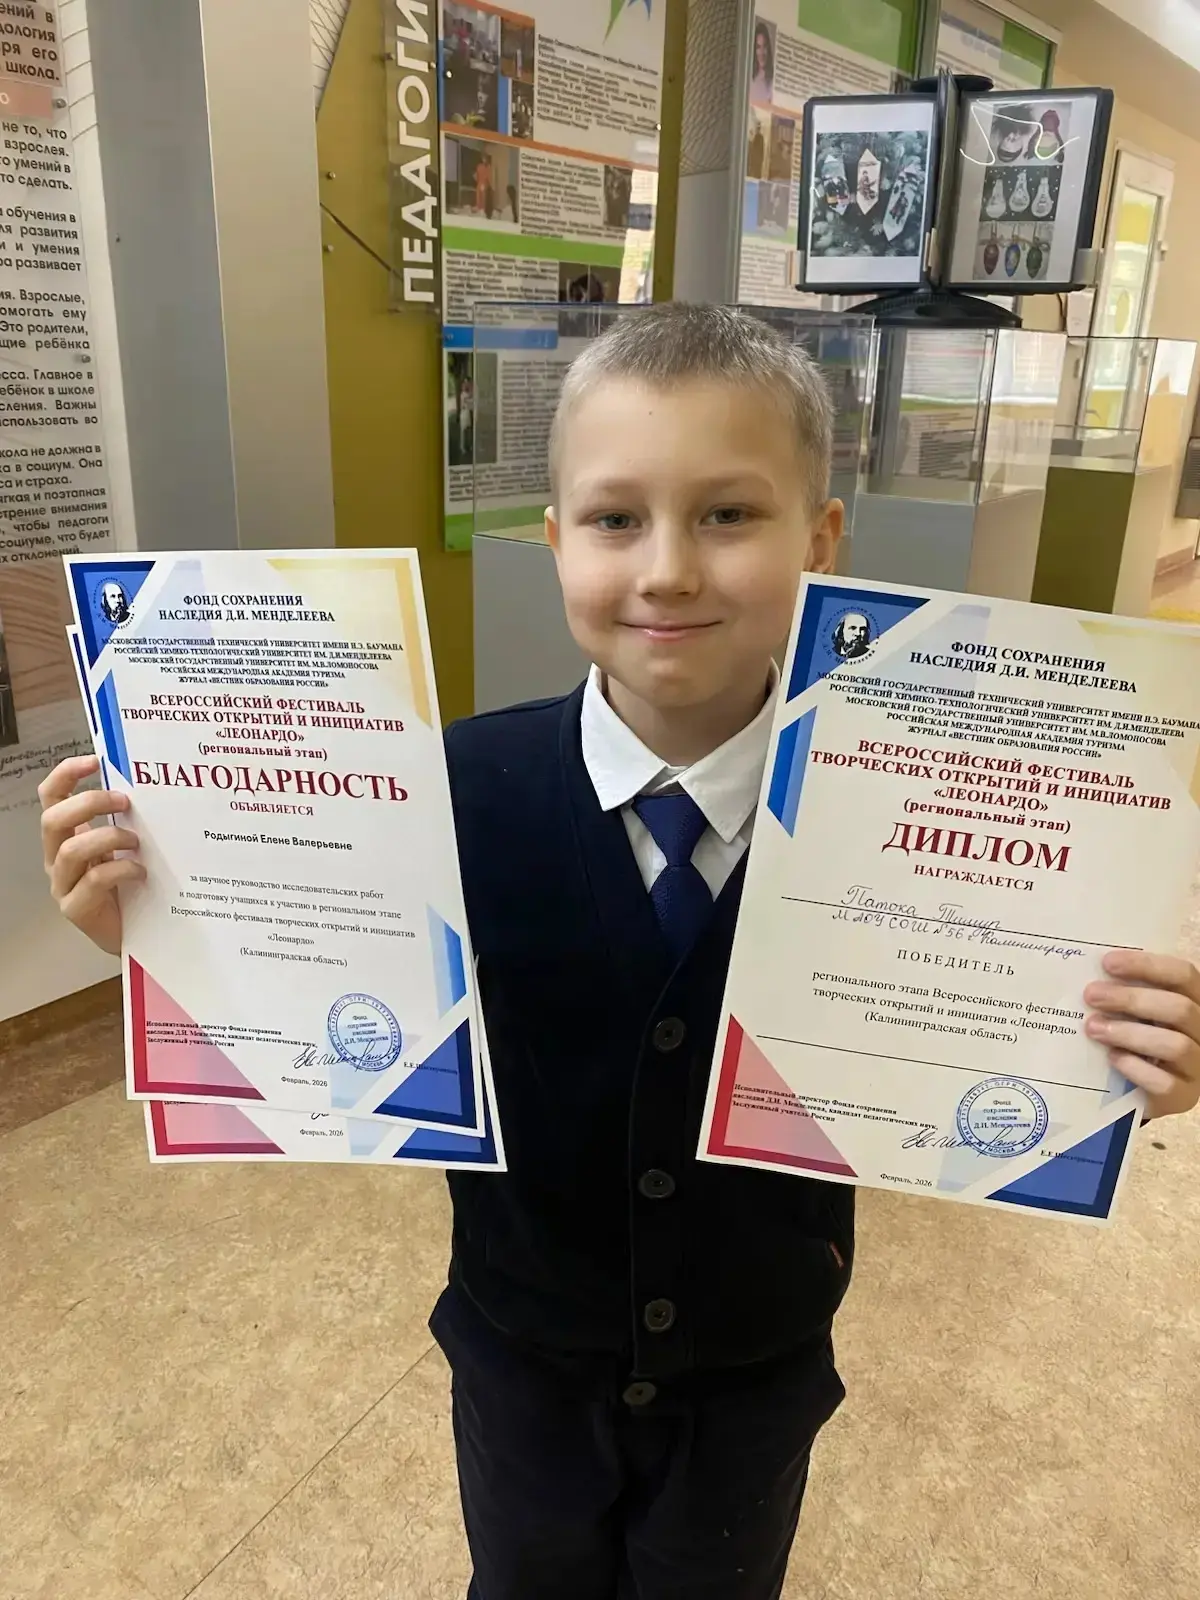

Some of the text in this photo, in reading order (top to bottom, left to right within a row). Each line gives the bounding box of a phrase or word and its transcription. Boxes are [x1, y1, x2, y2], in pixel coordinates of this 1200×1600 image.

[45, 11, 53, 23] в
[31, 47, 58, 62] его
[5, 61, 59, 80] школа.
[2, 122, 67, 139] не то, что
[4, 139, 69, 156] взрослея.
[12, 157, 70, 173] умений в
[18, 175, 72, 190] сделать.
[6, 206, 76, 222] обучения в
[20, 226, 78, 239] развития
[15, 242, 79, 255] и умения
[15, 258, 81, 271] развивает
[19, 289, 85, 305] Взрослые,
[62, 309, 86, 321] ему
[0, 320, 88, 336] Это родители,
[35, 337, 90, 351] ребёнка
[33, 368, 93, 380] Главное в
[48, 387, 54, 395] в
[57, 386, 94, 395] школе
[55, 399, 96, 410] Важны
[84, 416, 98, 424] во
[30, 448, 45, 456] не
[48, 445, 92, 456] должна
[15, 458, 102, 472] в социум. Она
[15, 476, 72, 488] и страха.
[33, 488, 106, 501] и поэтапная
[50, 502, 107, 514] внимания
[13, 516, 108, 532] чтобы педагоги
[57, 533, 76, 542] что
[78, 529, 109, 541] будет
[183, 594, 303, 606] ФОНД СОХРАНЕНИЯ
[159, 609, 335, 622] НАСЛЕДИЯ Д.И. МЕНДЕЛЕЕВА
[951, 642, 1105, 672] ФОНД СОХРАНЕНИЯ
[910, 652, 1136, 693] НАСЛЕДИЯ Д.И. МЕНДЕЛЕЕВА
[150, 693, 364, 713] ВСЕРОССИЙСКИЙ ФЕСТИВАЛЬ
[829, 683, 892, 698] РОССИЙСКИЙ
[894, 692, 1029, 716] ХИМИКО-ТЕХНОЛОГИЧЕСКИЙ
[1031, 710, 1095, 725] УНИВЕРСИТЕТ
[1096, 719, 1112, 728] ИМ.
[121, 708, 404, 731] ТВОРЧЕСКИХ ОТКРЫТИЙ И ИНИЦИАТИВ
[845, 696, 910, 711] МОСКОВСКИЙ
[912, 705, 1004, 724] ГОСУДАРСТВЕННЫЙ
[1006, 718, 1070, 732] УНИВЕРСИТЕТ
[1072, 727, 1088, 735] ИМ.
[216, 727, 304, 743] «ЛЕОНАРДО»
[886, 712, 1124, 750] РОССИЙСКАЯ МЕЖДУНАРОДНАЯ АКАДЕМИЯ ТУРИЗМА
[198, 742, 327, 761] (региональный этап)
[857, 740, 1134, 788] ВСЕРОССИЙСКИЙ ФЕСТИВАЛЬ
[134, 761, 408, 801] БЛАГОДАРНОСТЬ
[810, 750, 1171, 809] ТВОРЧЕСКИХ ОТКРЫТИЙ И ИНИЦИАТИВ
[934, 786, 1048, 811] «ЛЕОНАРДО»
[230, 801, 313, 816] ОБЪЯВЛЯЕТСЯ
[904, 798, 1070, 834] (региональный этап)
[204, 830, 352, 850] Родыгиной Елене Валерьевне
[881, 822, 1072, 872] ДИПЛОМ
[914, 864, 1033, 891] НАГРАЖДАЕТСЯ
[199, 876, 230, 885] научное
[231, 879, 280, 889] руководство
[282, 884, 358, 896] исследовательских
[360, 889, 383, 899] работ
[186, 892, 228, 903] подготовку
[230, 896, 268, 905] учащихся
[276, 900, 310, 909] участию
[318, 905, 376, 916] региональном
[378, 910, 401, 919] этапе
[170, 905, 231, 919] Всероссийского
[233, 912, 272, 923] фестиваля
[274, 918, 319, 928] творческих
[320, 923, 360, 932] открытий
[370, 928, 415, 938] инициатив
[267, 933, 314, 945] «Леонардо»
[240, 947, 347, 967] (Калининградская область)
[897, 949, 1014, 975] ПОБЕДИТЕЛЬ
[812, 972, 1084, 1019] регионального этапа Всероссийского фестиваля
[813, 988, 876, 1004] творческих
[879, 999, 933, 1013] открытий
[947, 1009, 1007, 1024] инициатив
[1010, 1017, 1076, 1034] «Леонардо»
[864, 1011, 1017, 1044] (Калининградская область)
[281, 1076, 327, 1087] Февраль, 2026
[299, 1128, 327, 1136] Февраль,
[880, 1173, 932, 1186] Февраль, 2026
